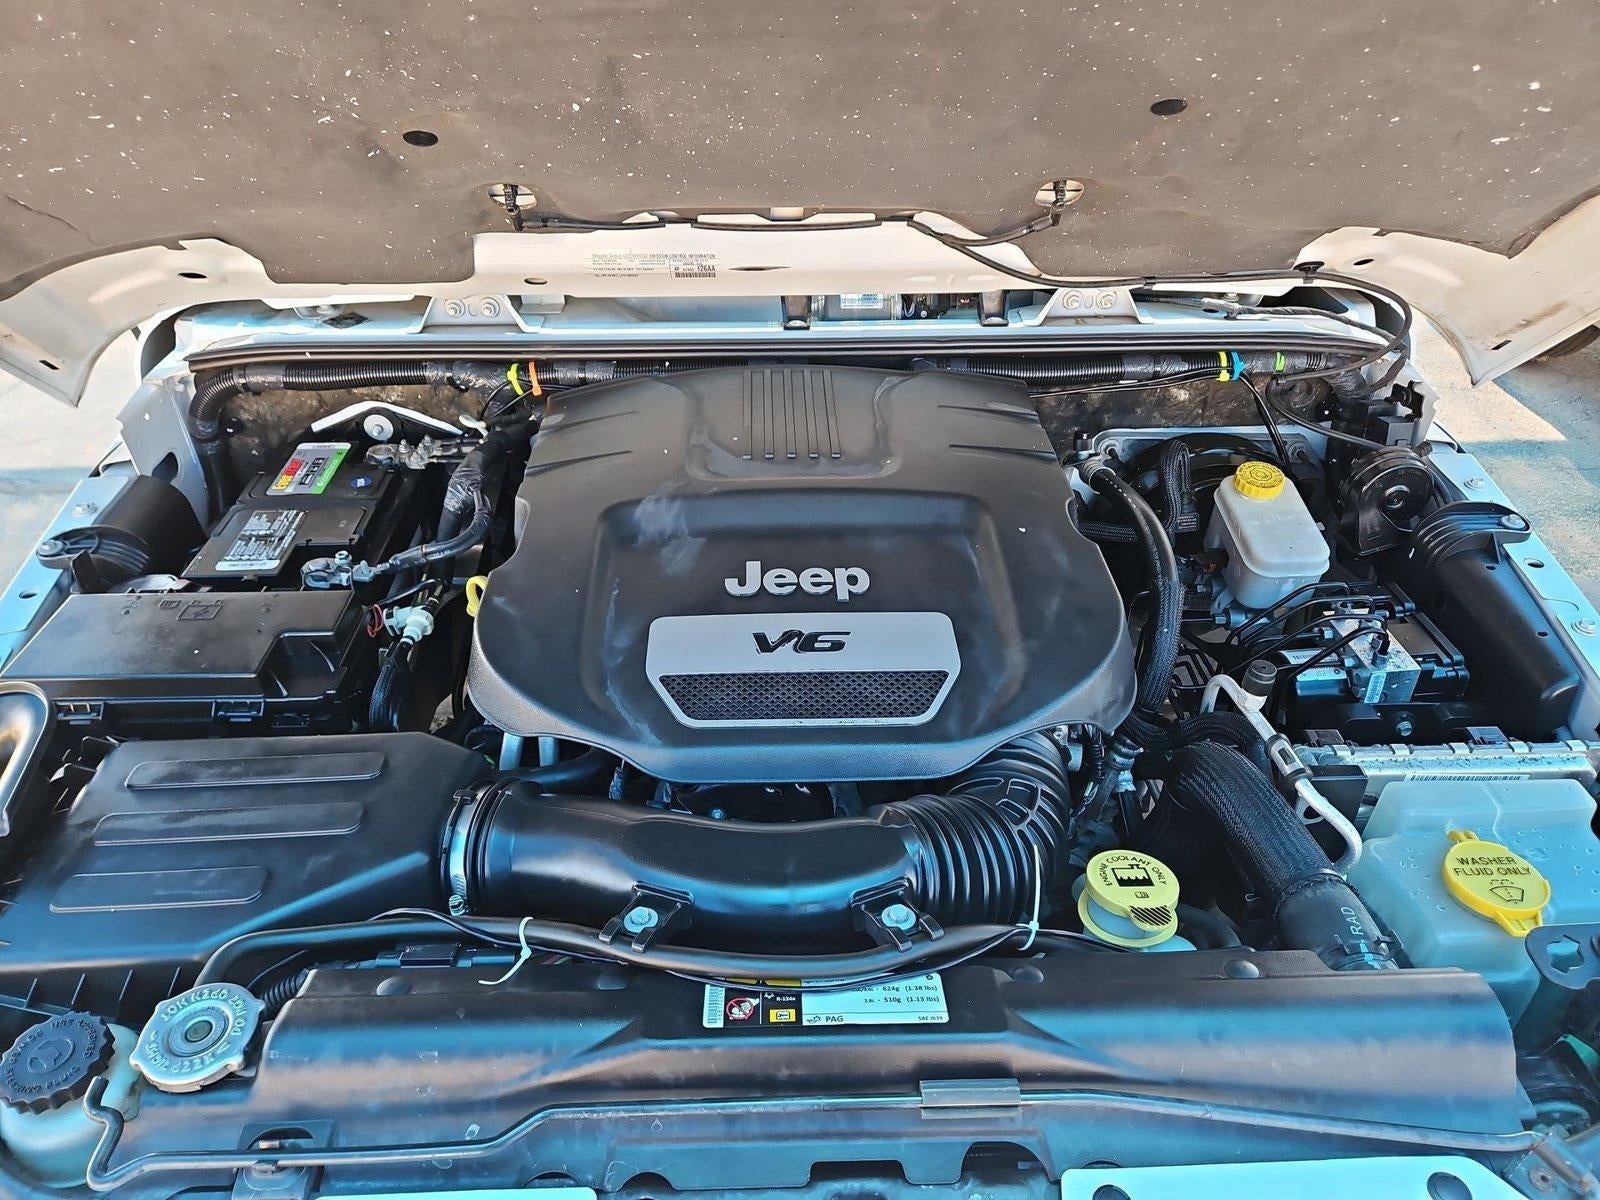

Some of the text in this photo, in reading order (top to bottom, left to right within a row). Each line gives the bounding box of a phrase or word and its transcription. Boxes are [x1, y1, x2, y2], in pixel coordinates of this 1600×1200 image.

[724, 560, 870, 602] Jeep
[752, 629, 851, 653] V6
[1099, 855, 1167, 887] ENGINE COOLANT ONLY
[1453, 866, 1531, 876] FLUID ONLY
[1455, 856, 1517, 865] WASHER
[1341, 906, 1364, 936] RAD
[231, 1018, 247, 1036] DO
[825, 1015, 844, 1023] PAG
